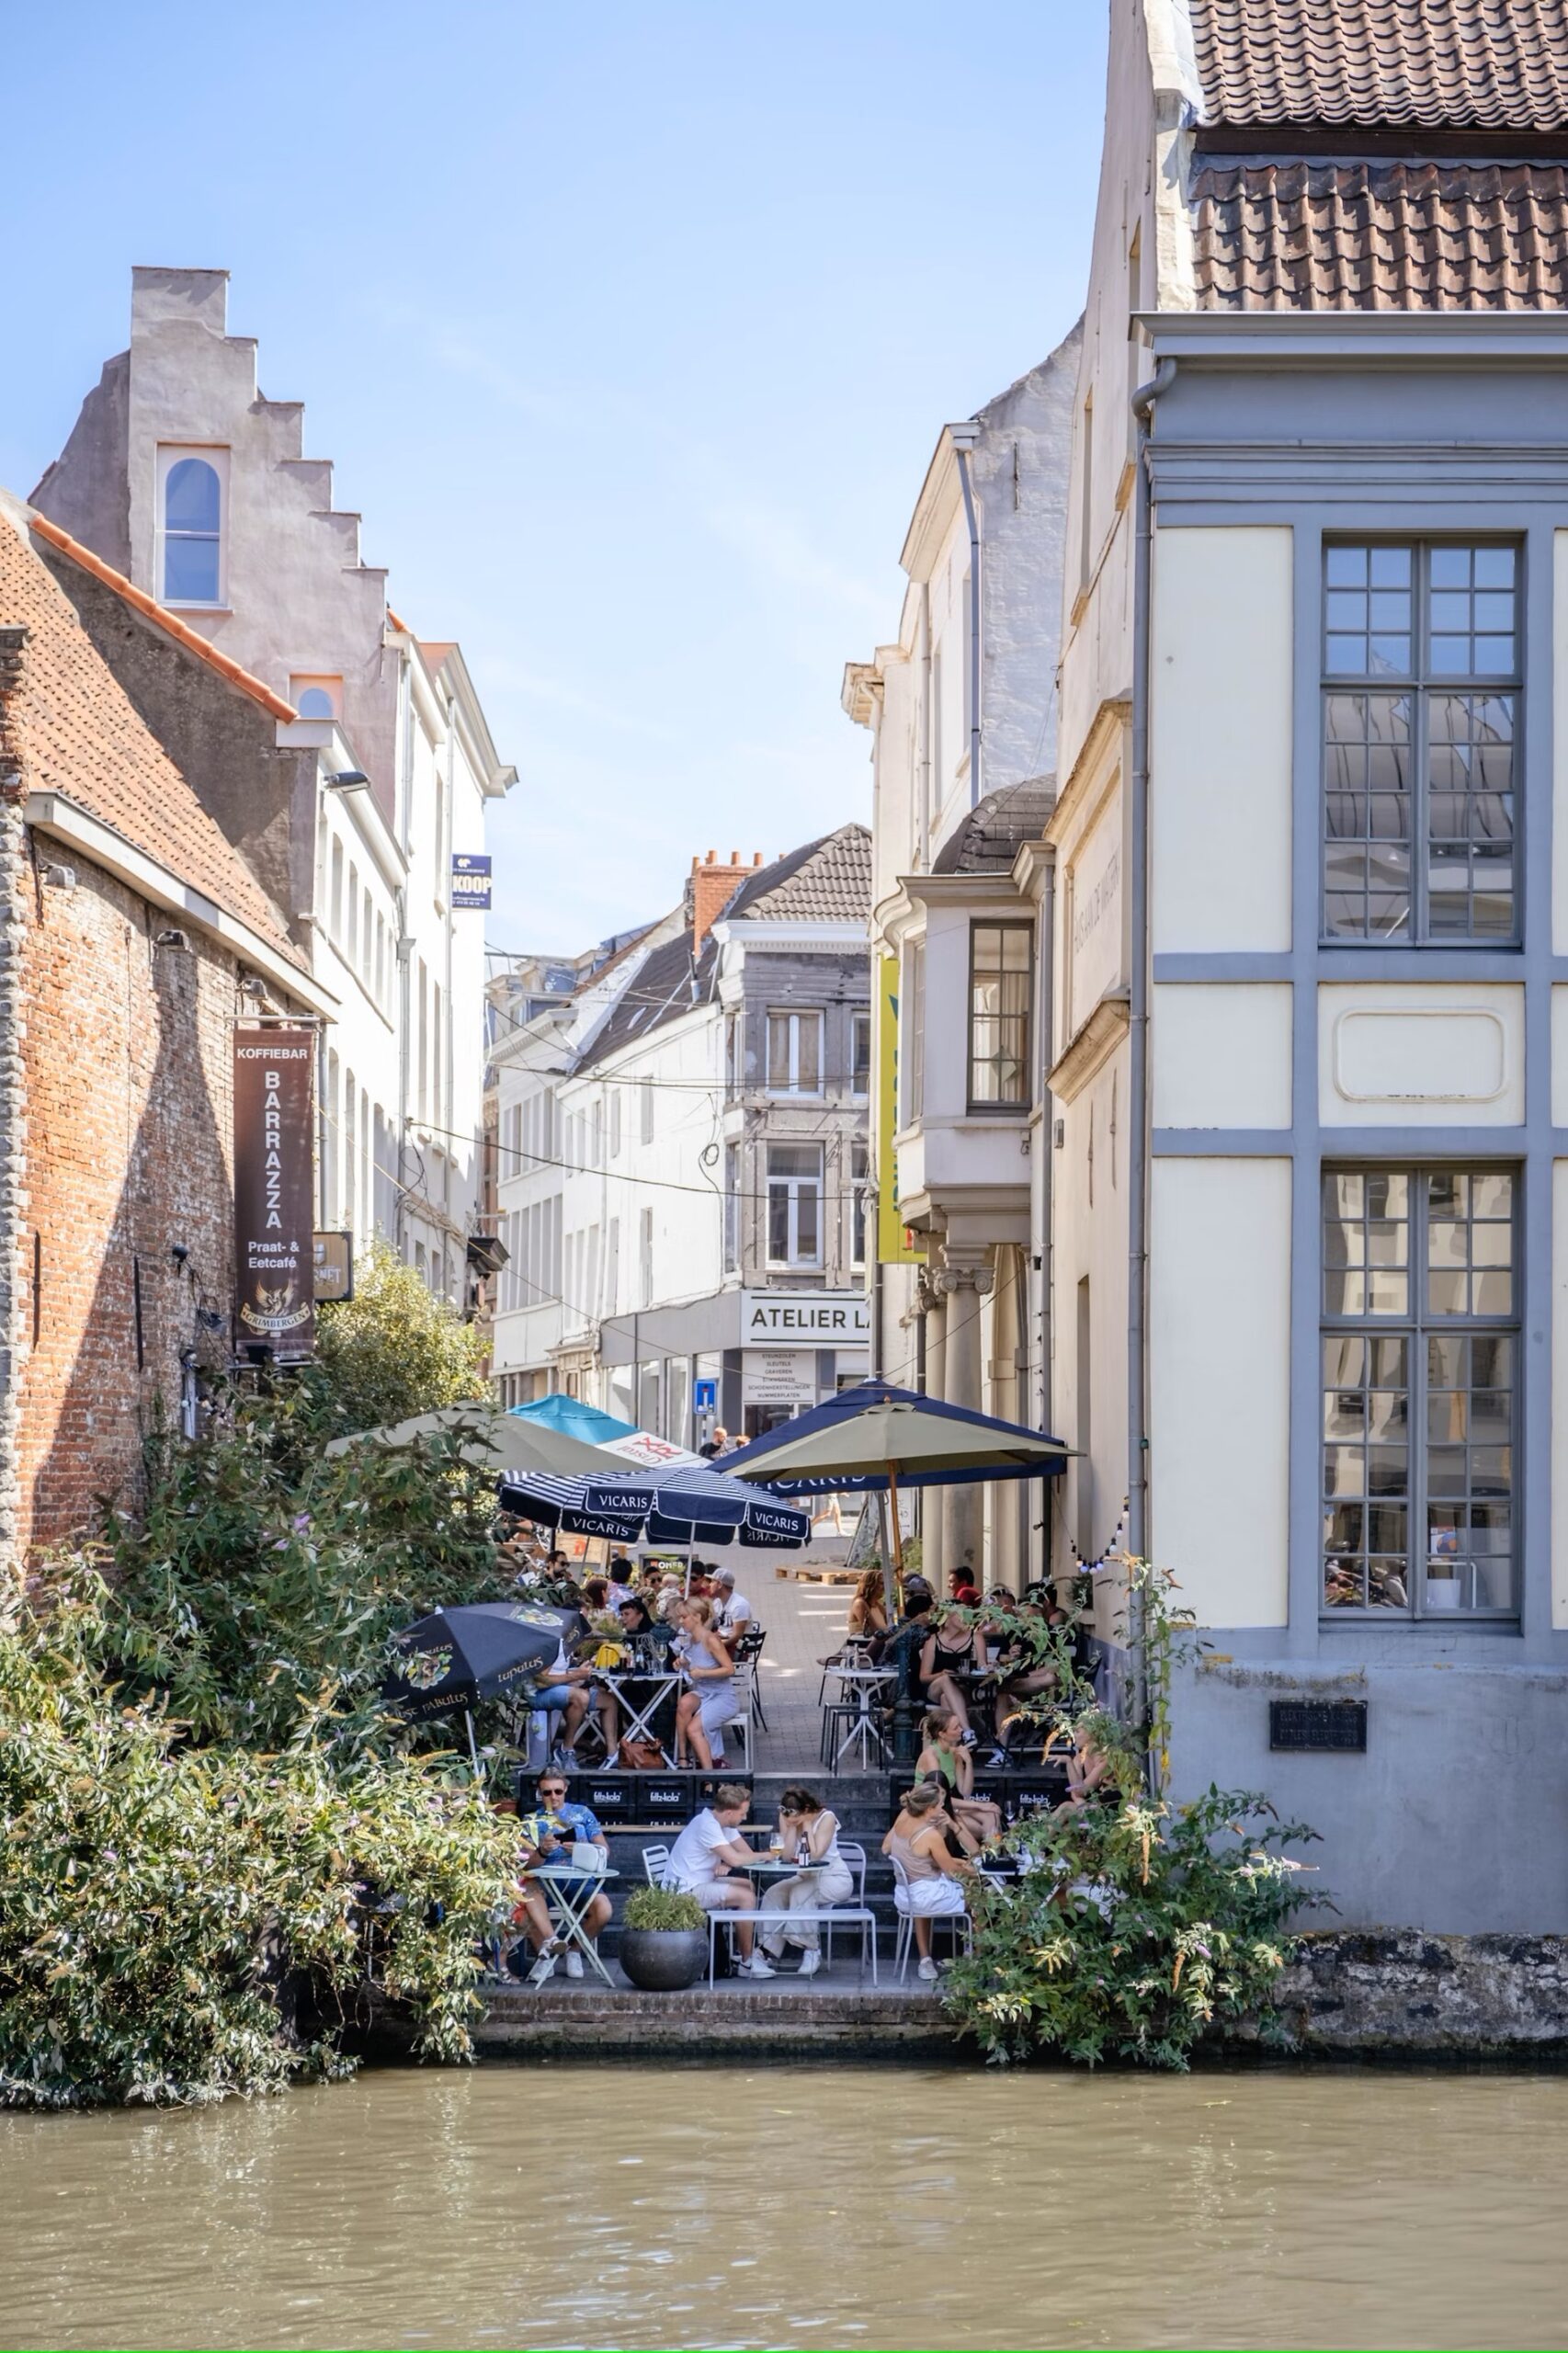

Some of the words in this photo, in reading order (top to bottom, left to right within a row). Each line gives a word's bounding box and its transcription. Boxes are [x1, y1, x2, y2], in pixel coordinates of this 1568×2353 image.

[451, 875, 493, 894] KOOP
[237, 1048, 308, 1060] KOFFIEBAR
[264, 1071, 283, 1229] BARRAZZA
[248, 1242, 287, 1253] Praat-
[290, 1242, 300, 1253] &
[248, 1256, 297, 1268] Eetcafé
[245, 1312, 307, 1327] GRIMBERGEN
[751, 1308, 846, 1329] ATELIER
[855, 1310, 870, 1329] L
[599, 1495, 648, 1508] VICARIS
[572, 1517, 630, 1537] VICARIS
[756, 1512, 799, 1531] VICARIS
[593, 1791, 621, 1802] fritz-kola
[650, 1791, 680, 1802] fritz-kola
